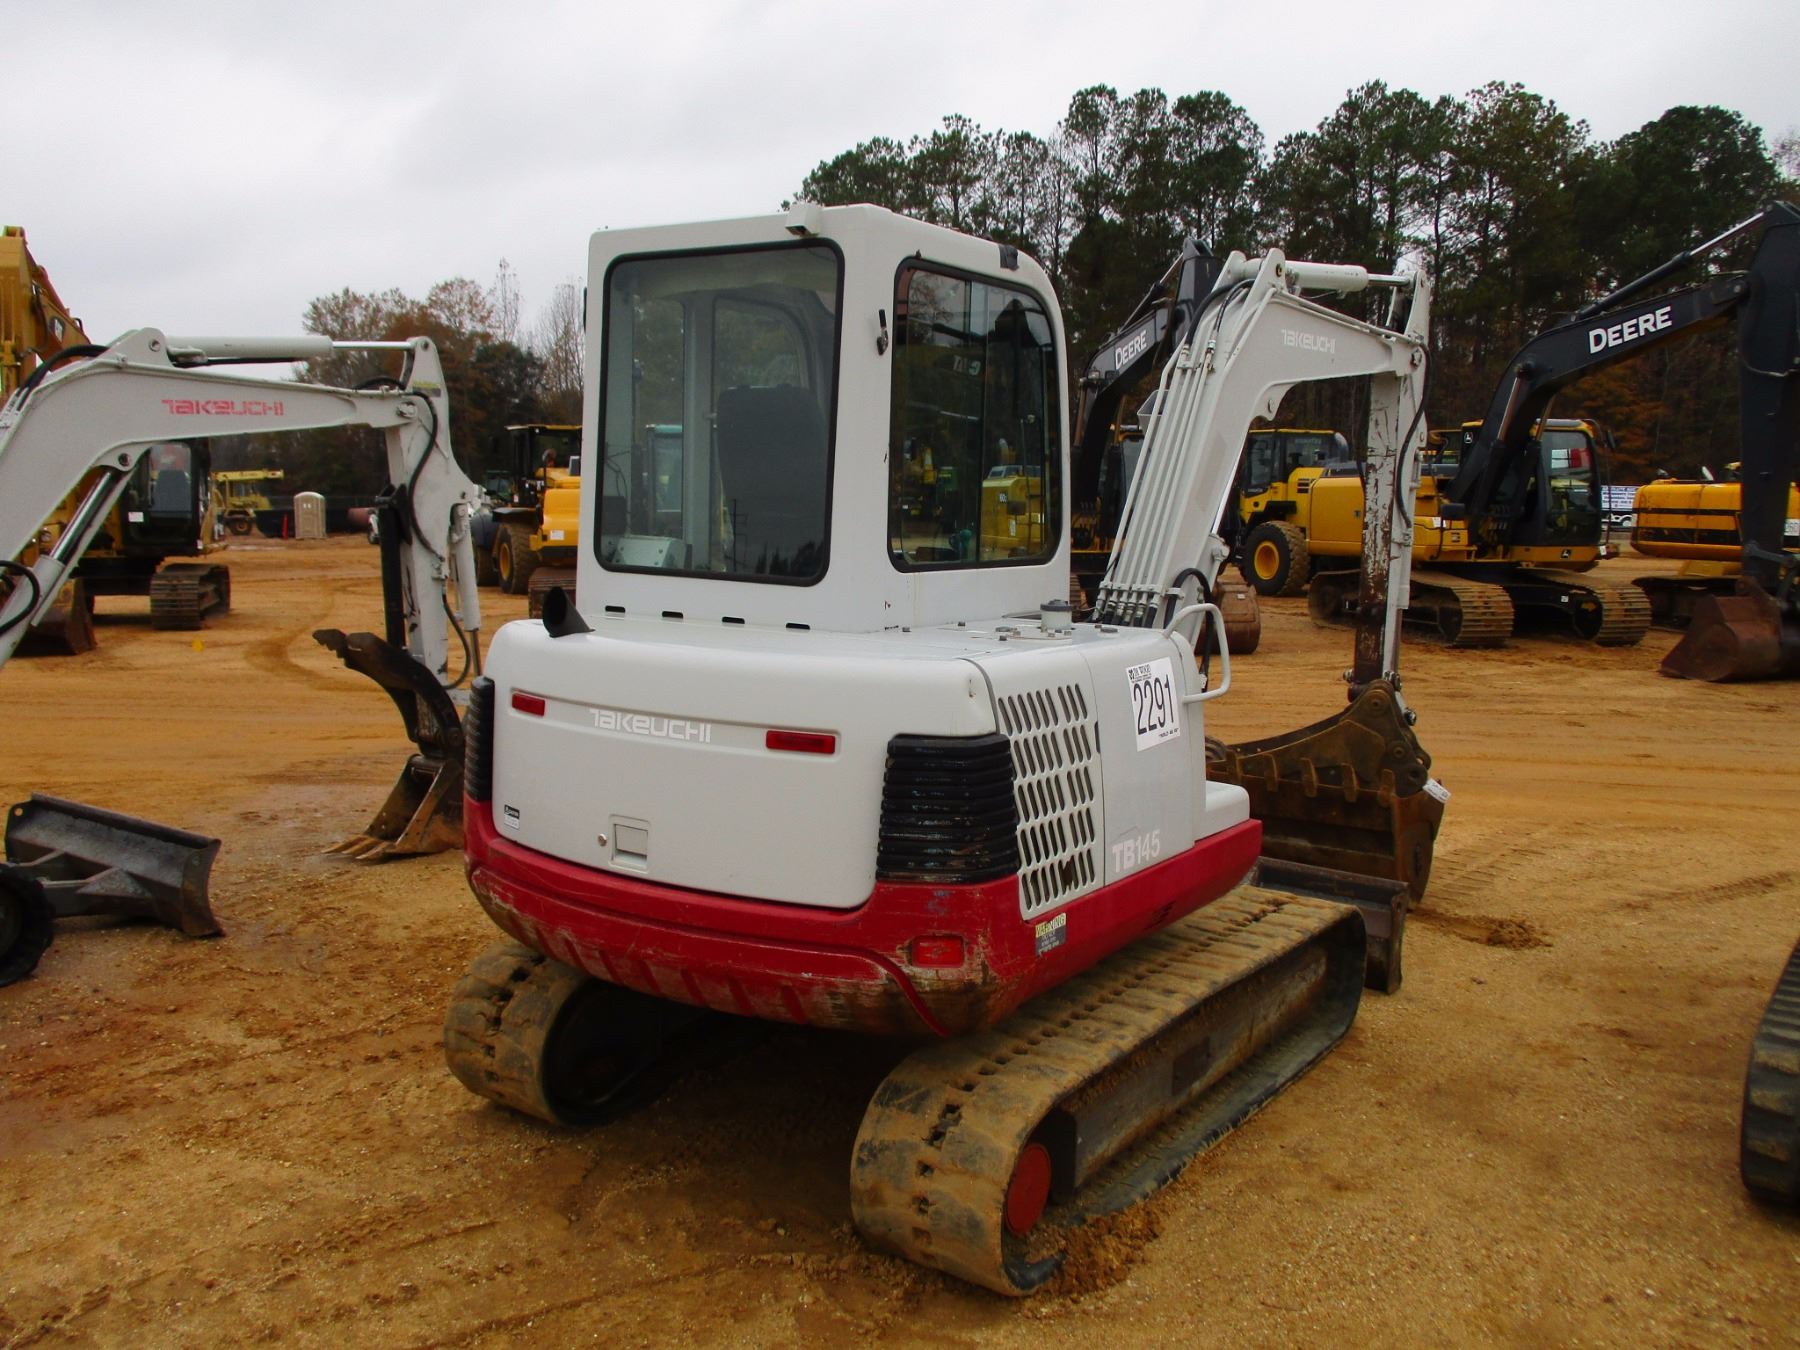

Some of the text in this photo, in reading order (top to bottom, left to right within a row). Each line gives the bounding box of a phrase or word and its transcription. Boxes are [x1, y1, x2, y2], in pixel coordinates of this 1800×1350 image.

[1114, 330, 1148, 370] DEERE
[1281, 328, 1337, 354] TAKEUCHI
[1588, 306, 1673, 354] DEERE
[161, 399, 284, 416] TAKEUCHI
[1133, 674, 1174, 735] 2291
[589, 708, 711, 743] TAKEUCHI
[1112, 829, 1160, 873] TB145
